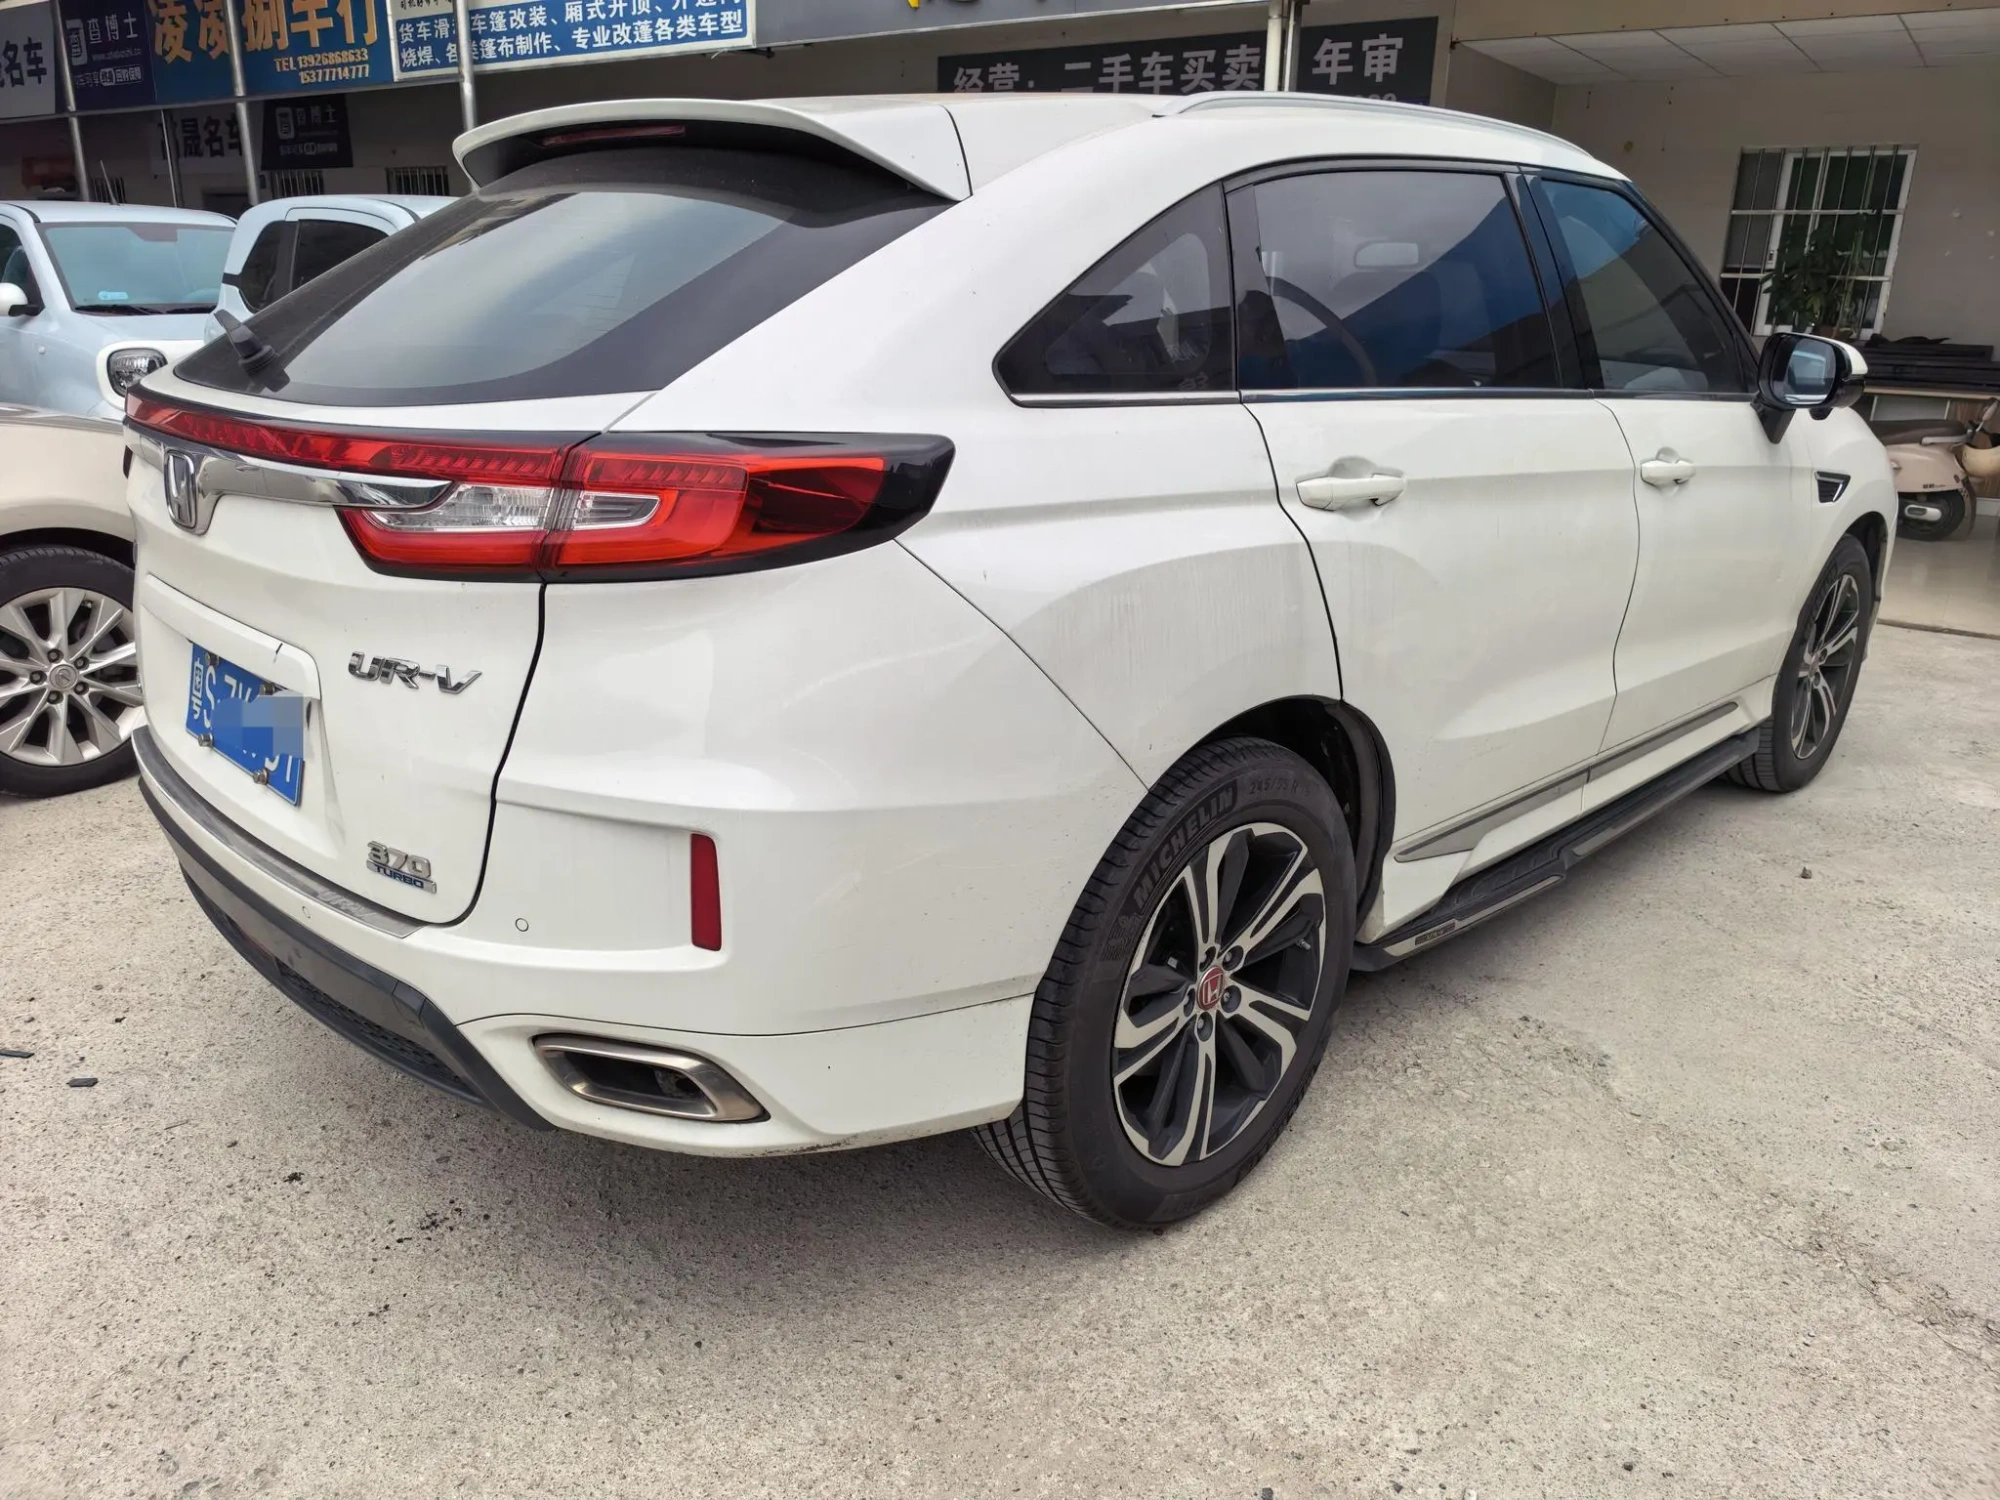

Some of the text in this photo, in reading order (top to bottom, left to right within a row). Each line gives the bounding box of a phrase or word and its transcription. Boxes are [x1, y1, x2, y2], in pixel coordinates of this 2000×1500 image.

[0, 36, 47, 88] 名车
[273, 56, 297, 72] TEL
[1311, 33, 1403, 85] 年审
[348, 650, 483, 695] UR-V
[366, 840, 432, 879] 370
[1133, 784, 1237, 909] MICHELIN
[373, 863, 424, 889] TURBO
